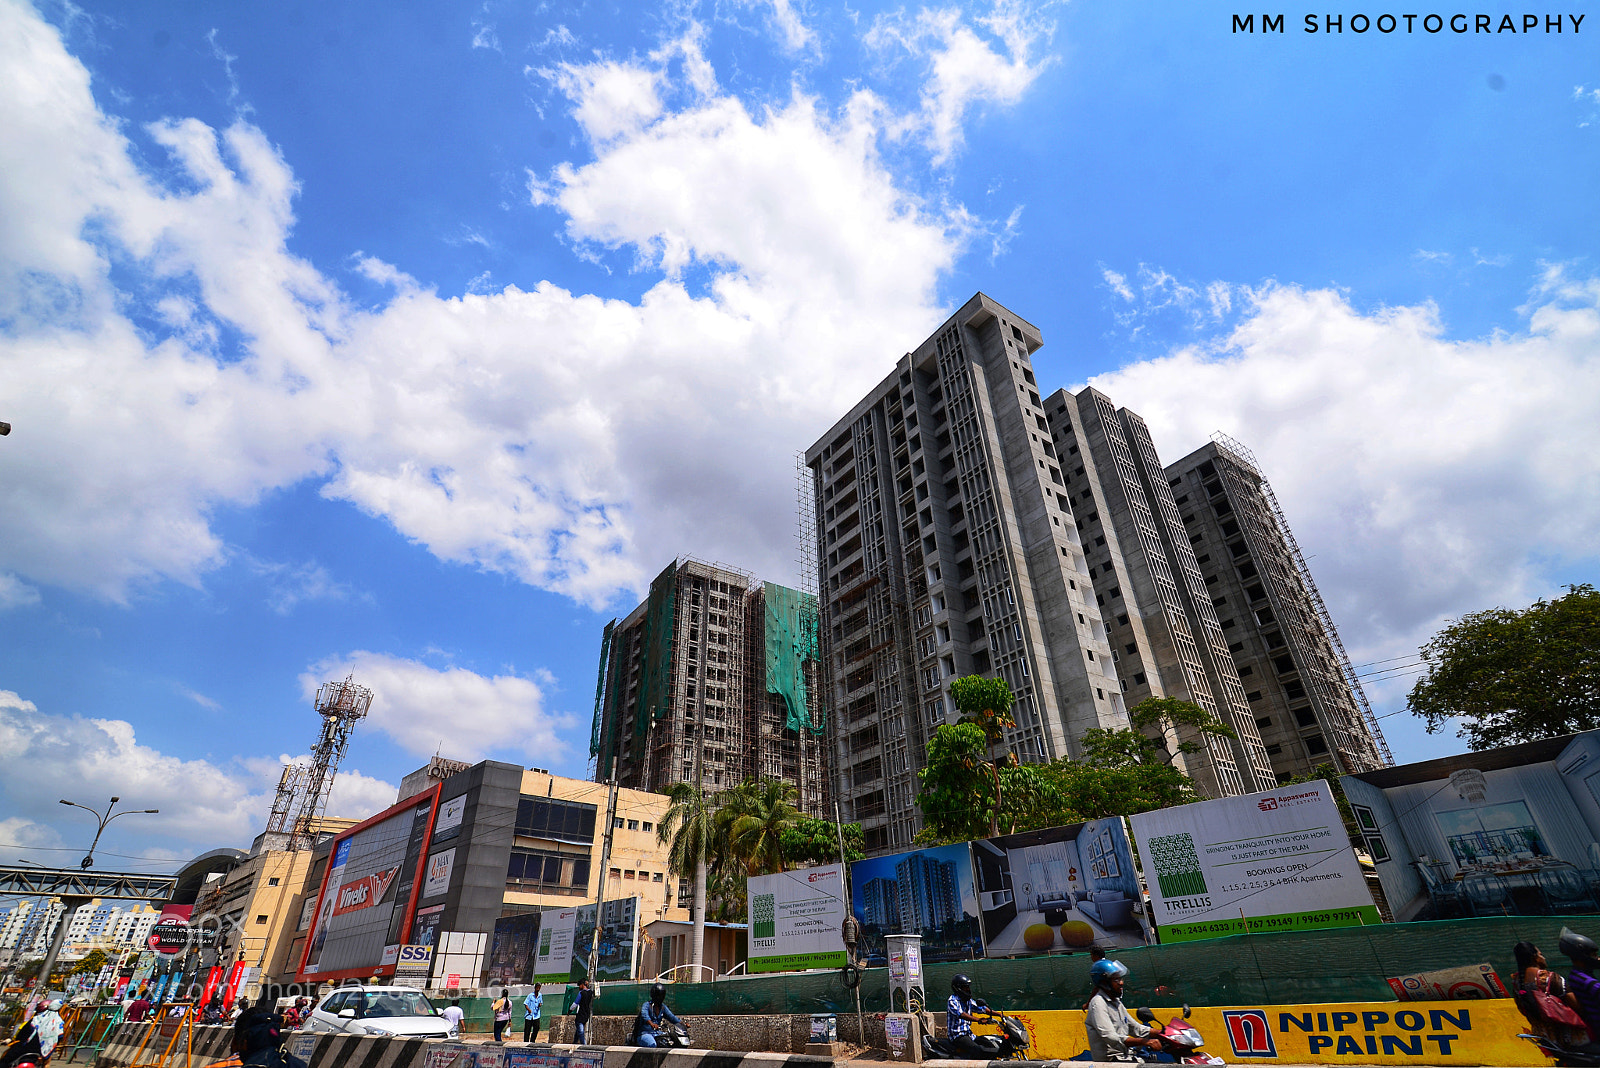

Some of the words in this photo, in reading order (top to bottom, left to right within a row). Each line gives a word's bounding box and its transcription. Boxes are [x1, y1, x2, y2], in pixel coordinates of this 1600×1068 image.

[1278, 790, 1319, 802] Appaswamy
[1206, 844, 1235, 854] BRINGING
[1235, 839, 1274, 850] TRANQUILITY
[1291, 834, 1310, 842] YOUR
[1310, 830, 1332, 839] HOME
[1246, 866, 1285, 877] BOOKINGS
[1287, 863, 1308, 872] OPEN
[1300, 872, 1343, 884] Apartments.
[340, 884, 370, 910] Viveks
[1164, 897, 1212, 910] TRELLIS
[1188, 925, 1207, 934] 2434
[1238, 920, 1263, 929] 9767
[1266, 917, 1292, 927] 19149
[1302, 914, 1330, 923] 99629
[753, 939, 775, 948] TRELLIS
[1279, 1009, 1472, 1032] NIPPON
[1308, 1034, 1459, 1056] PAINT
